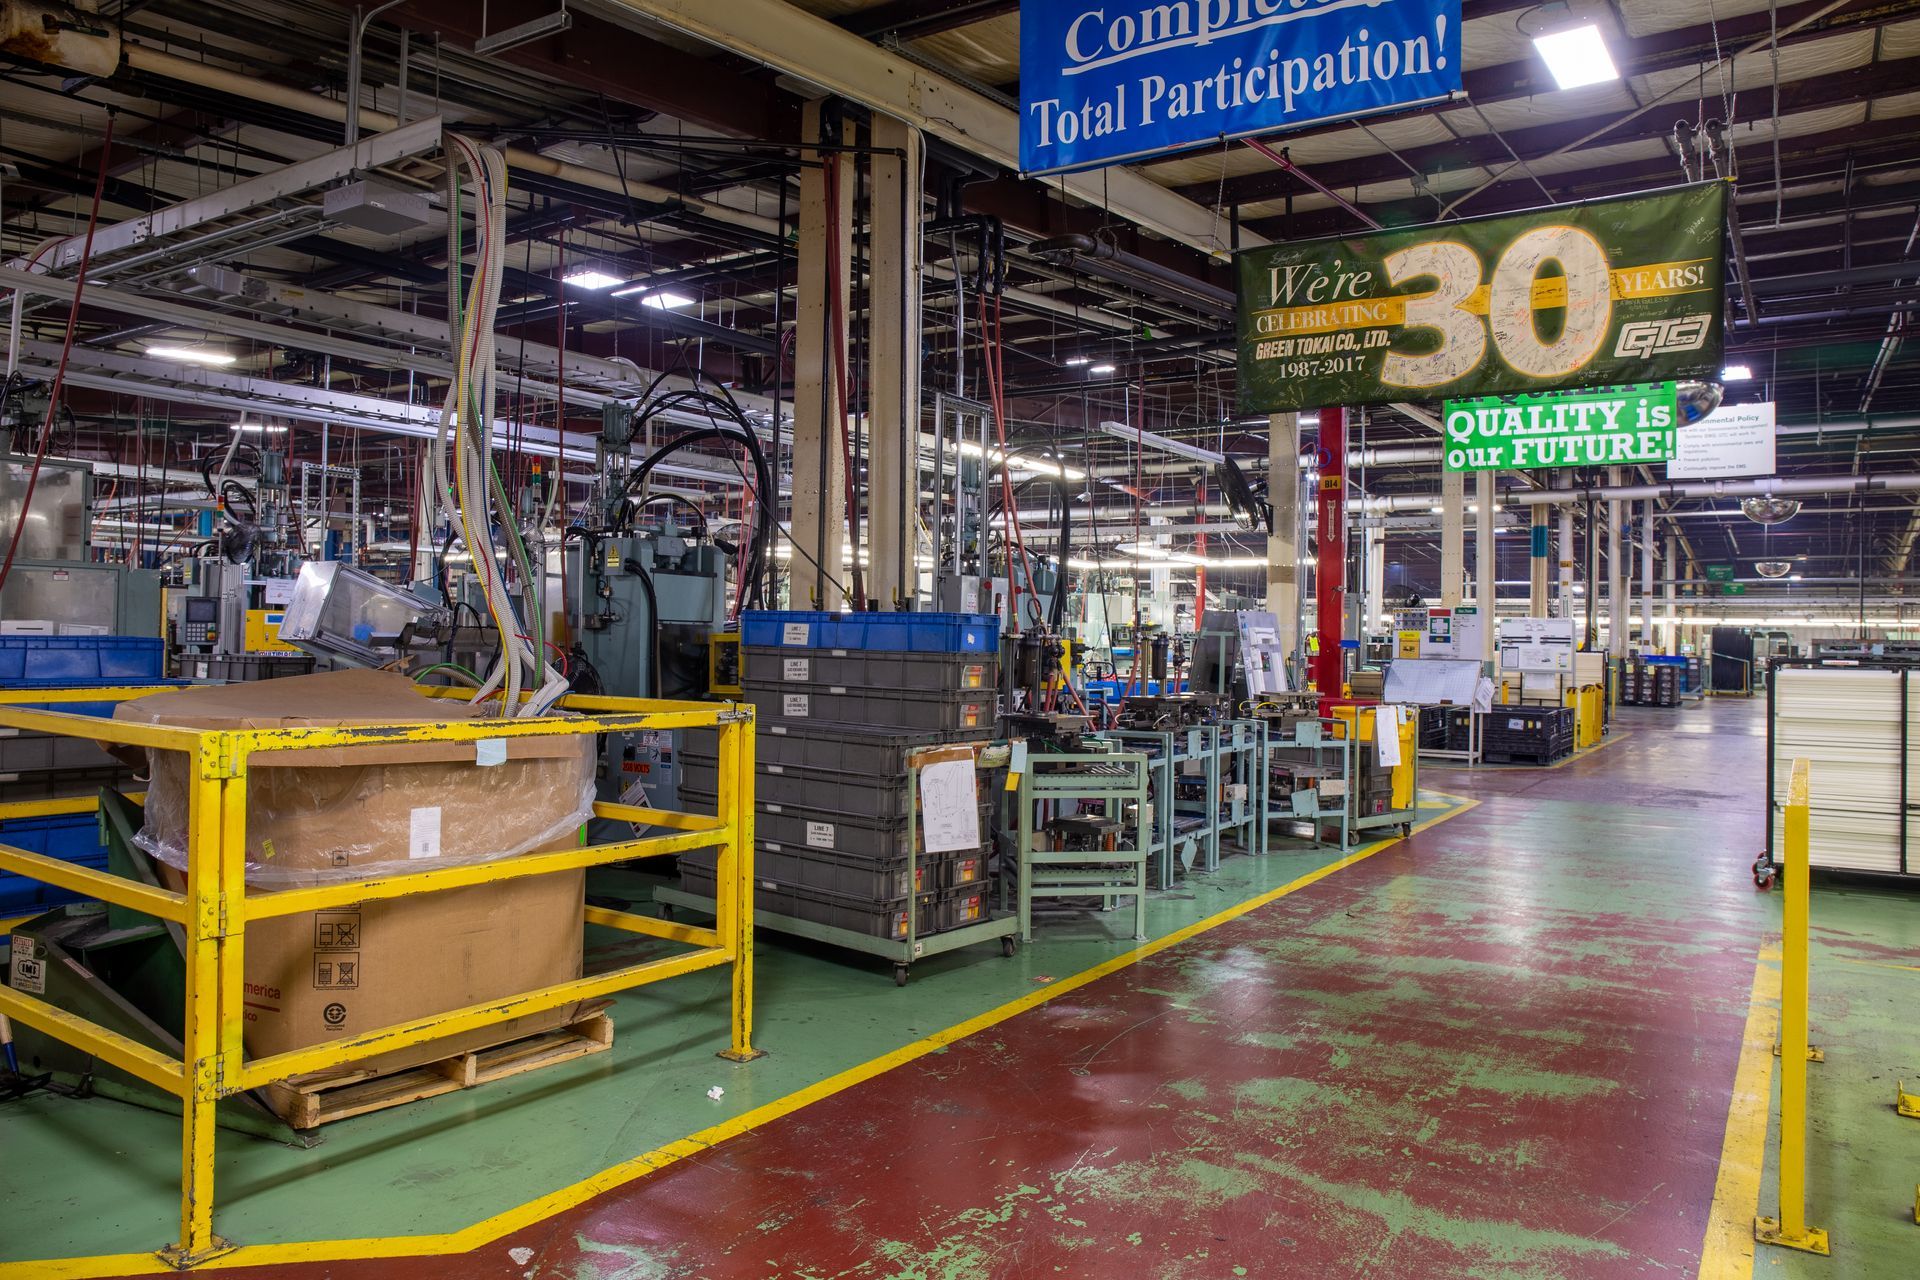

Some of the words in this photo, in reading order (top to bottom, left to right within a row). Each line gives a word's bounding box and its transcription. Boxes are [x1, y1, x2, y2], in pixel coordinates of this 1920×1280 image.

[1030, 94, 1127, 147] Total
[1138, 14, 1448, 126] Participation!
[1266, 259, 1372, 306] We're
[1619, 265, 1705, 293] YEARS!
[1255, 302, 1388, 333] CELEBRATING
[1380, 225, 1613, 389] 30
[1255, 338, 1295, 360] GREEN
[1296, 334, 1335, 355] TOKAI
[1336, 333, 1361, 351] CO.,
[1363, 330, 1391, 349] LTD.
[1279, 355, 1366, 379] 1987-2017
[1446, 400, 1626, 444] QUALITY
[1636, 398, 1671, 429] is
[1696, 416, 1735, 425] onmental
[1737, 414, 1760, 423] Policy
[1447, 446, 1504, 468] our
[1511, 430, 1674, 466] FUTURE!
[243, 982, 280, 999] merica
[243, 1009, 258, 1022] ico
